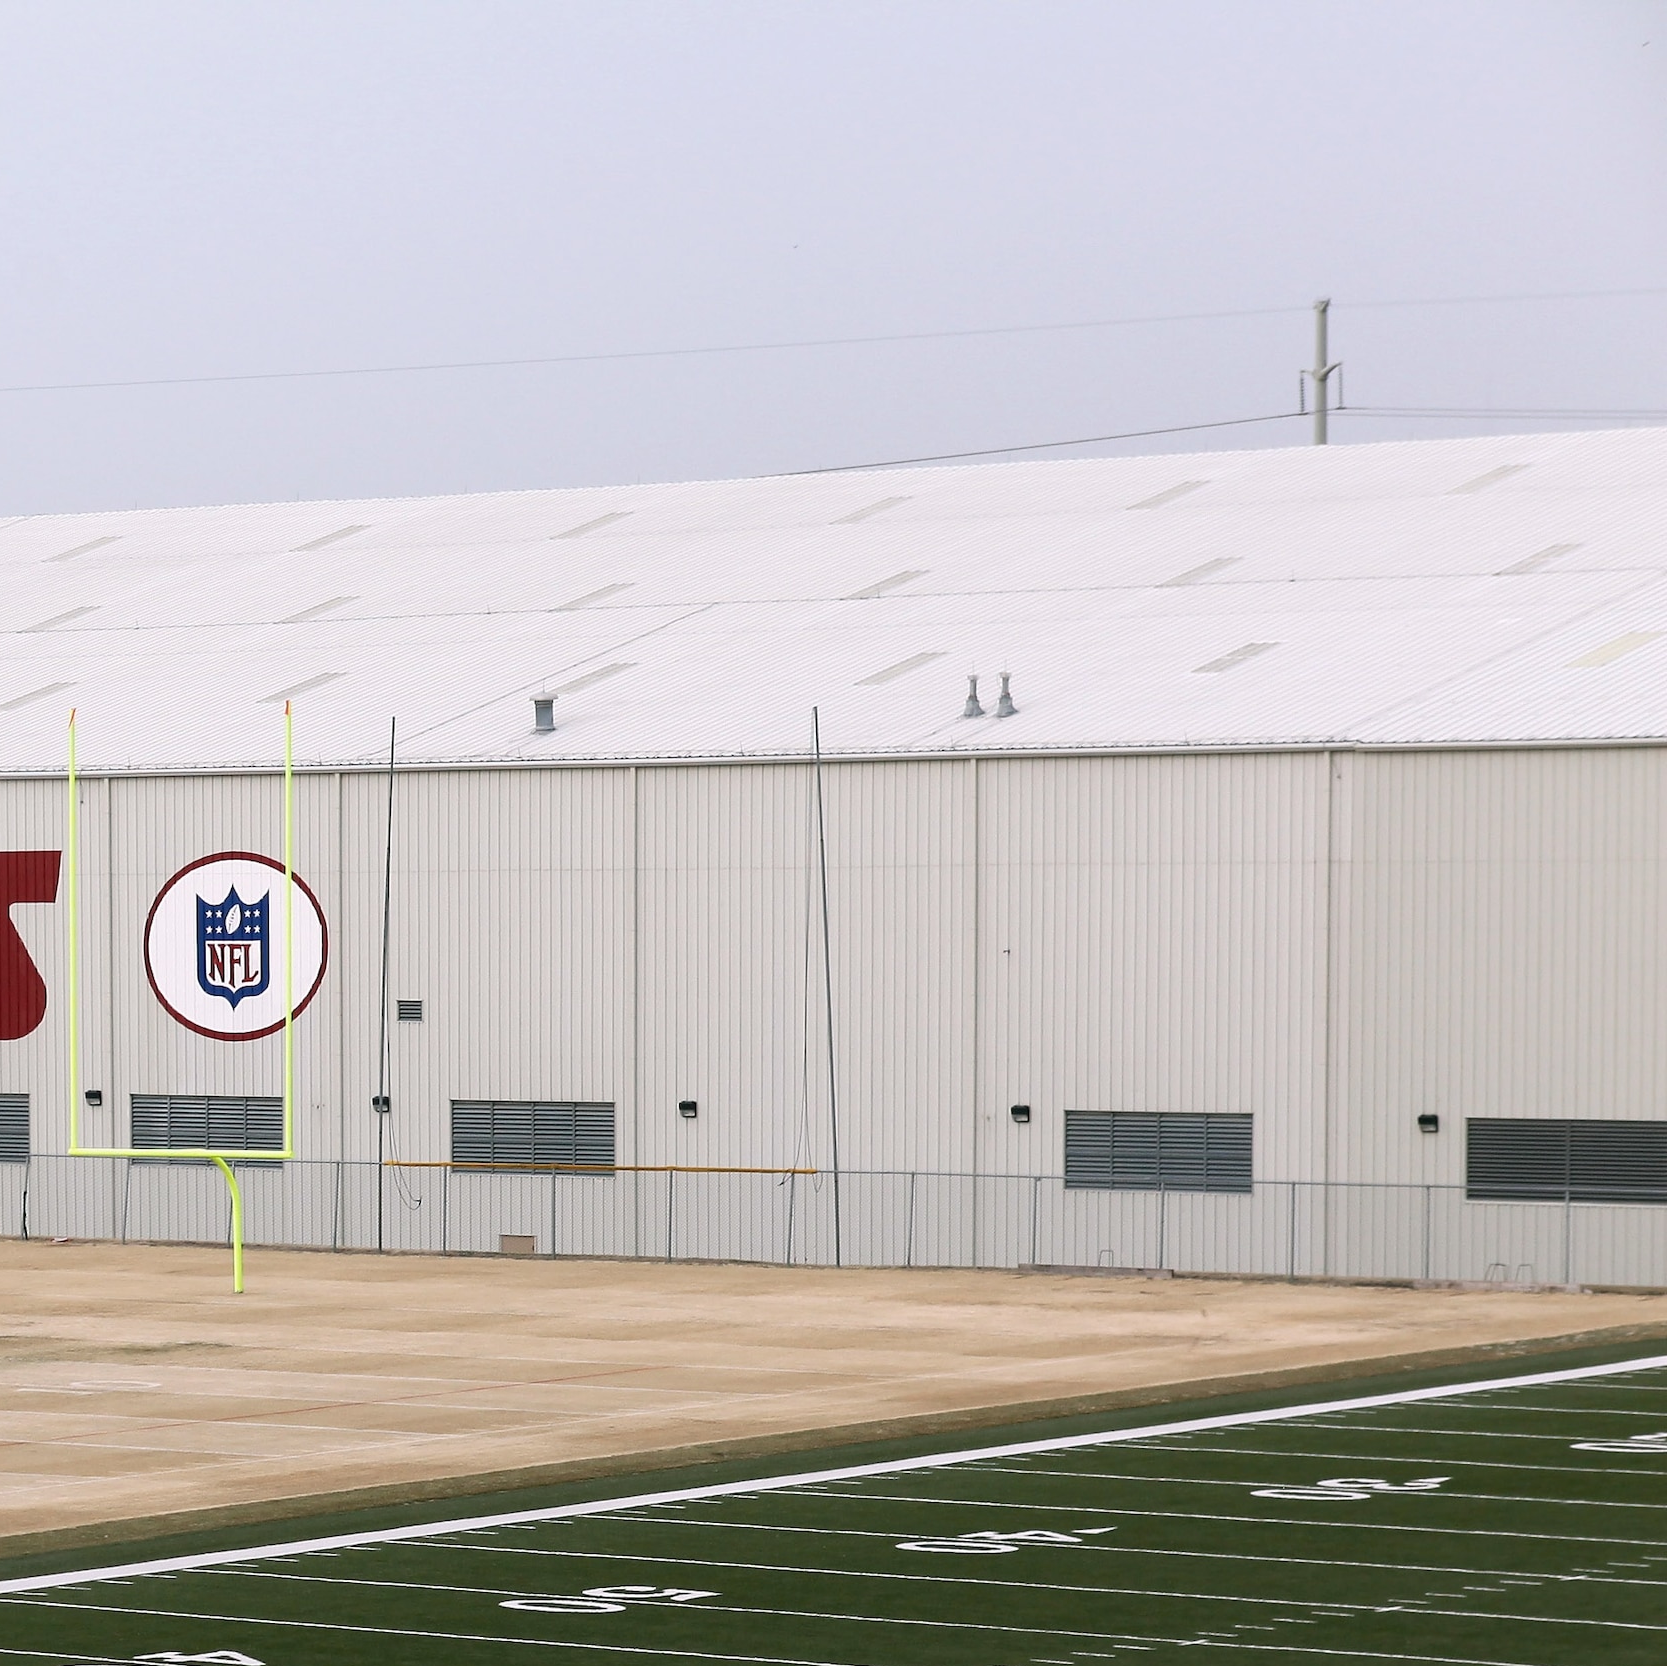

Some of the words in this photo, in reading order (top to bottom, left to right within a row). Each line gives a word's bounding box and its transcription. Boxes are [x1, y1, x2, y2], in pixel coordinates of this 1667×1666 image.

[207, 943, 259, 988] NFL
[1250, 1478, 1441, 1501] 30
[895, 1530, 1083, 1554] 40
[498, 1586, 723, 1613] 50
